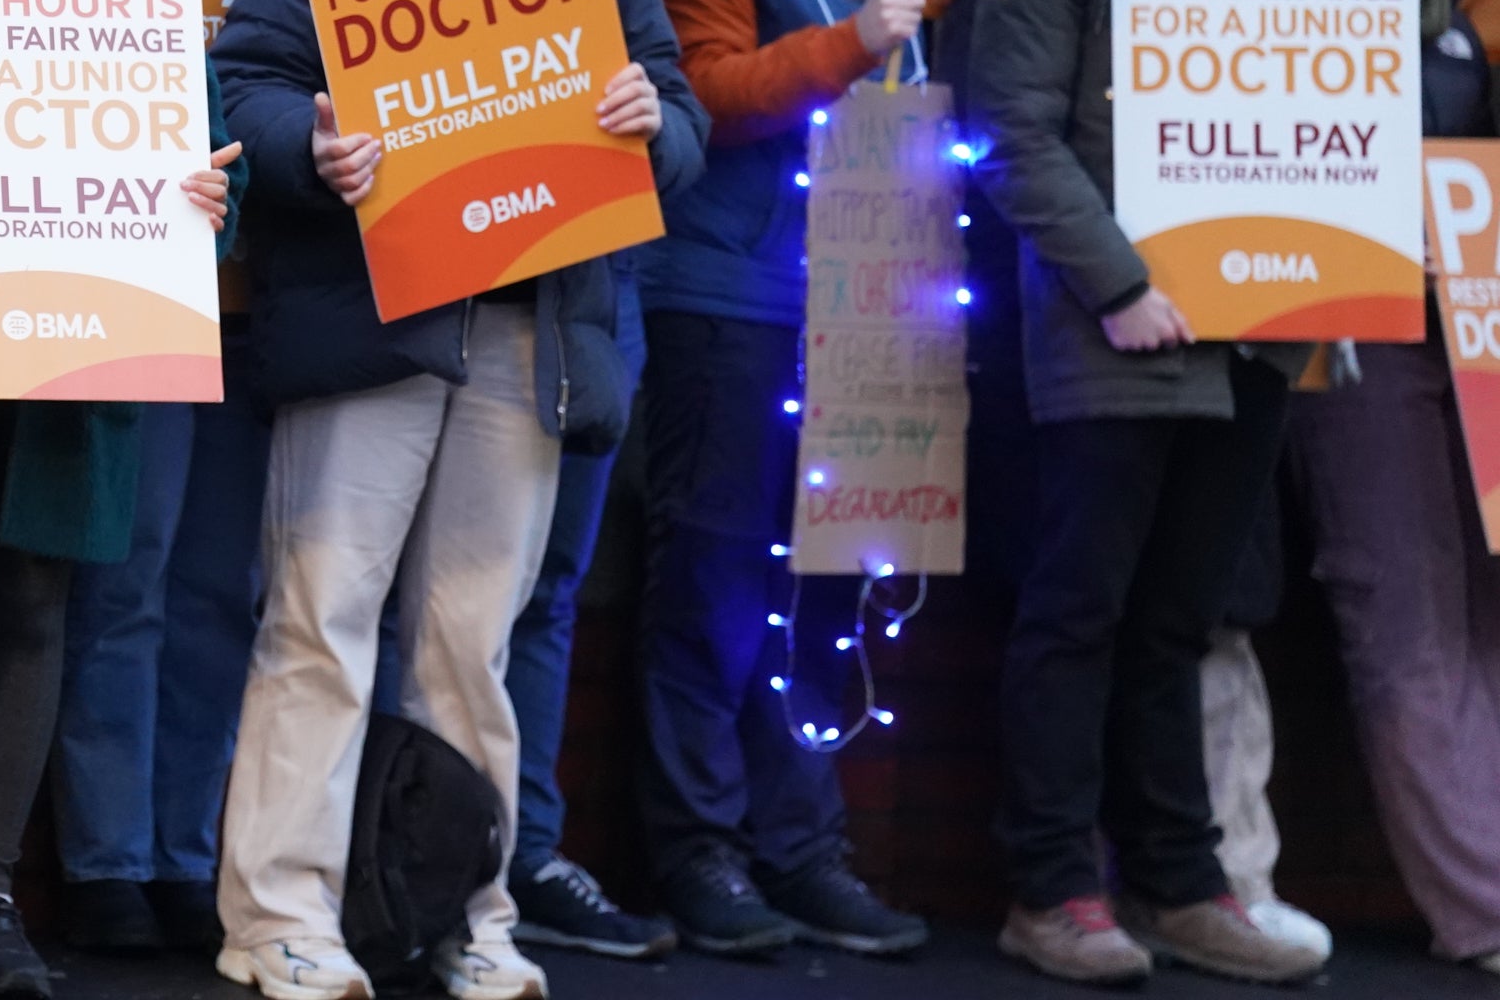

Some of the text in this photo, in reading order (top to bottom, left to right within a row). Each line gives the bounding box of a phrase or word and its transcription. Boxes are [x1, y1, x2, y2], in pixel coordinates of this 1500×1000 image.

[7, 26, 80, 51] FAIR
[89, 28, 185, 53] WAGE
[1131, 6, 1402, 43] FOR A JUNIOR
[31, 60, 187, 95] JUNIOR
[374, 27, 583, 128] FULL PAY
[1132, 46, 1402, 95] DOCTOR
[383, 71, 592, 153] RESTORATION NOW
[1158, 122, 1378, 159] FULL PAY
[1158, 163, 1379, 184] RESTORATION NOW
[76, 177, 167, 215] PAY
[491, 183, 555, 225] BMA
[111, 222, 168, 240] NOW
[1253, 254, 1318, 282] BMA
[36, 313, 107, 340] BMA
